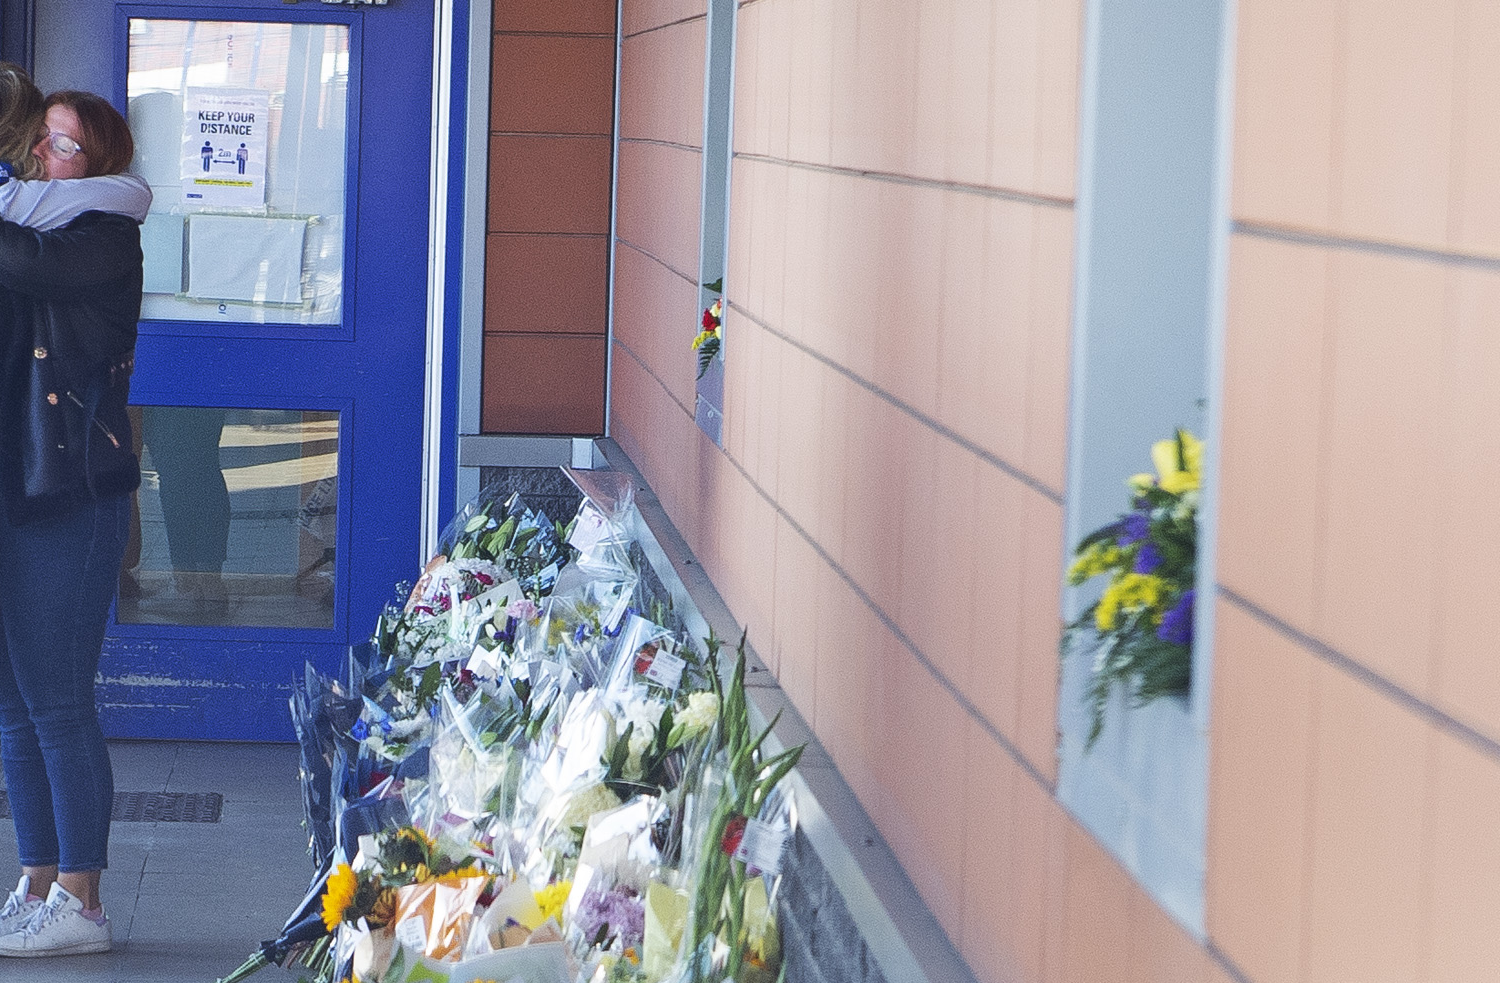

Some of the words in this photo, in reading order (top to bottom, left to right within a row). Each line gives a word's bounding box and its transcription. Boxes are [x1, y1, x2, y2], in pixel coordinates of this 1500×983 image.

[198, 110, 224, 121] KEEP
[227, 112, 255, 123] YOUR
[200, 123, 252, 135] DISTANCE
[218, 148, 231, 157] 2m
